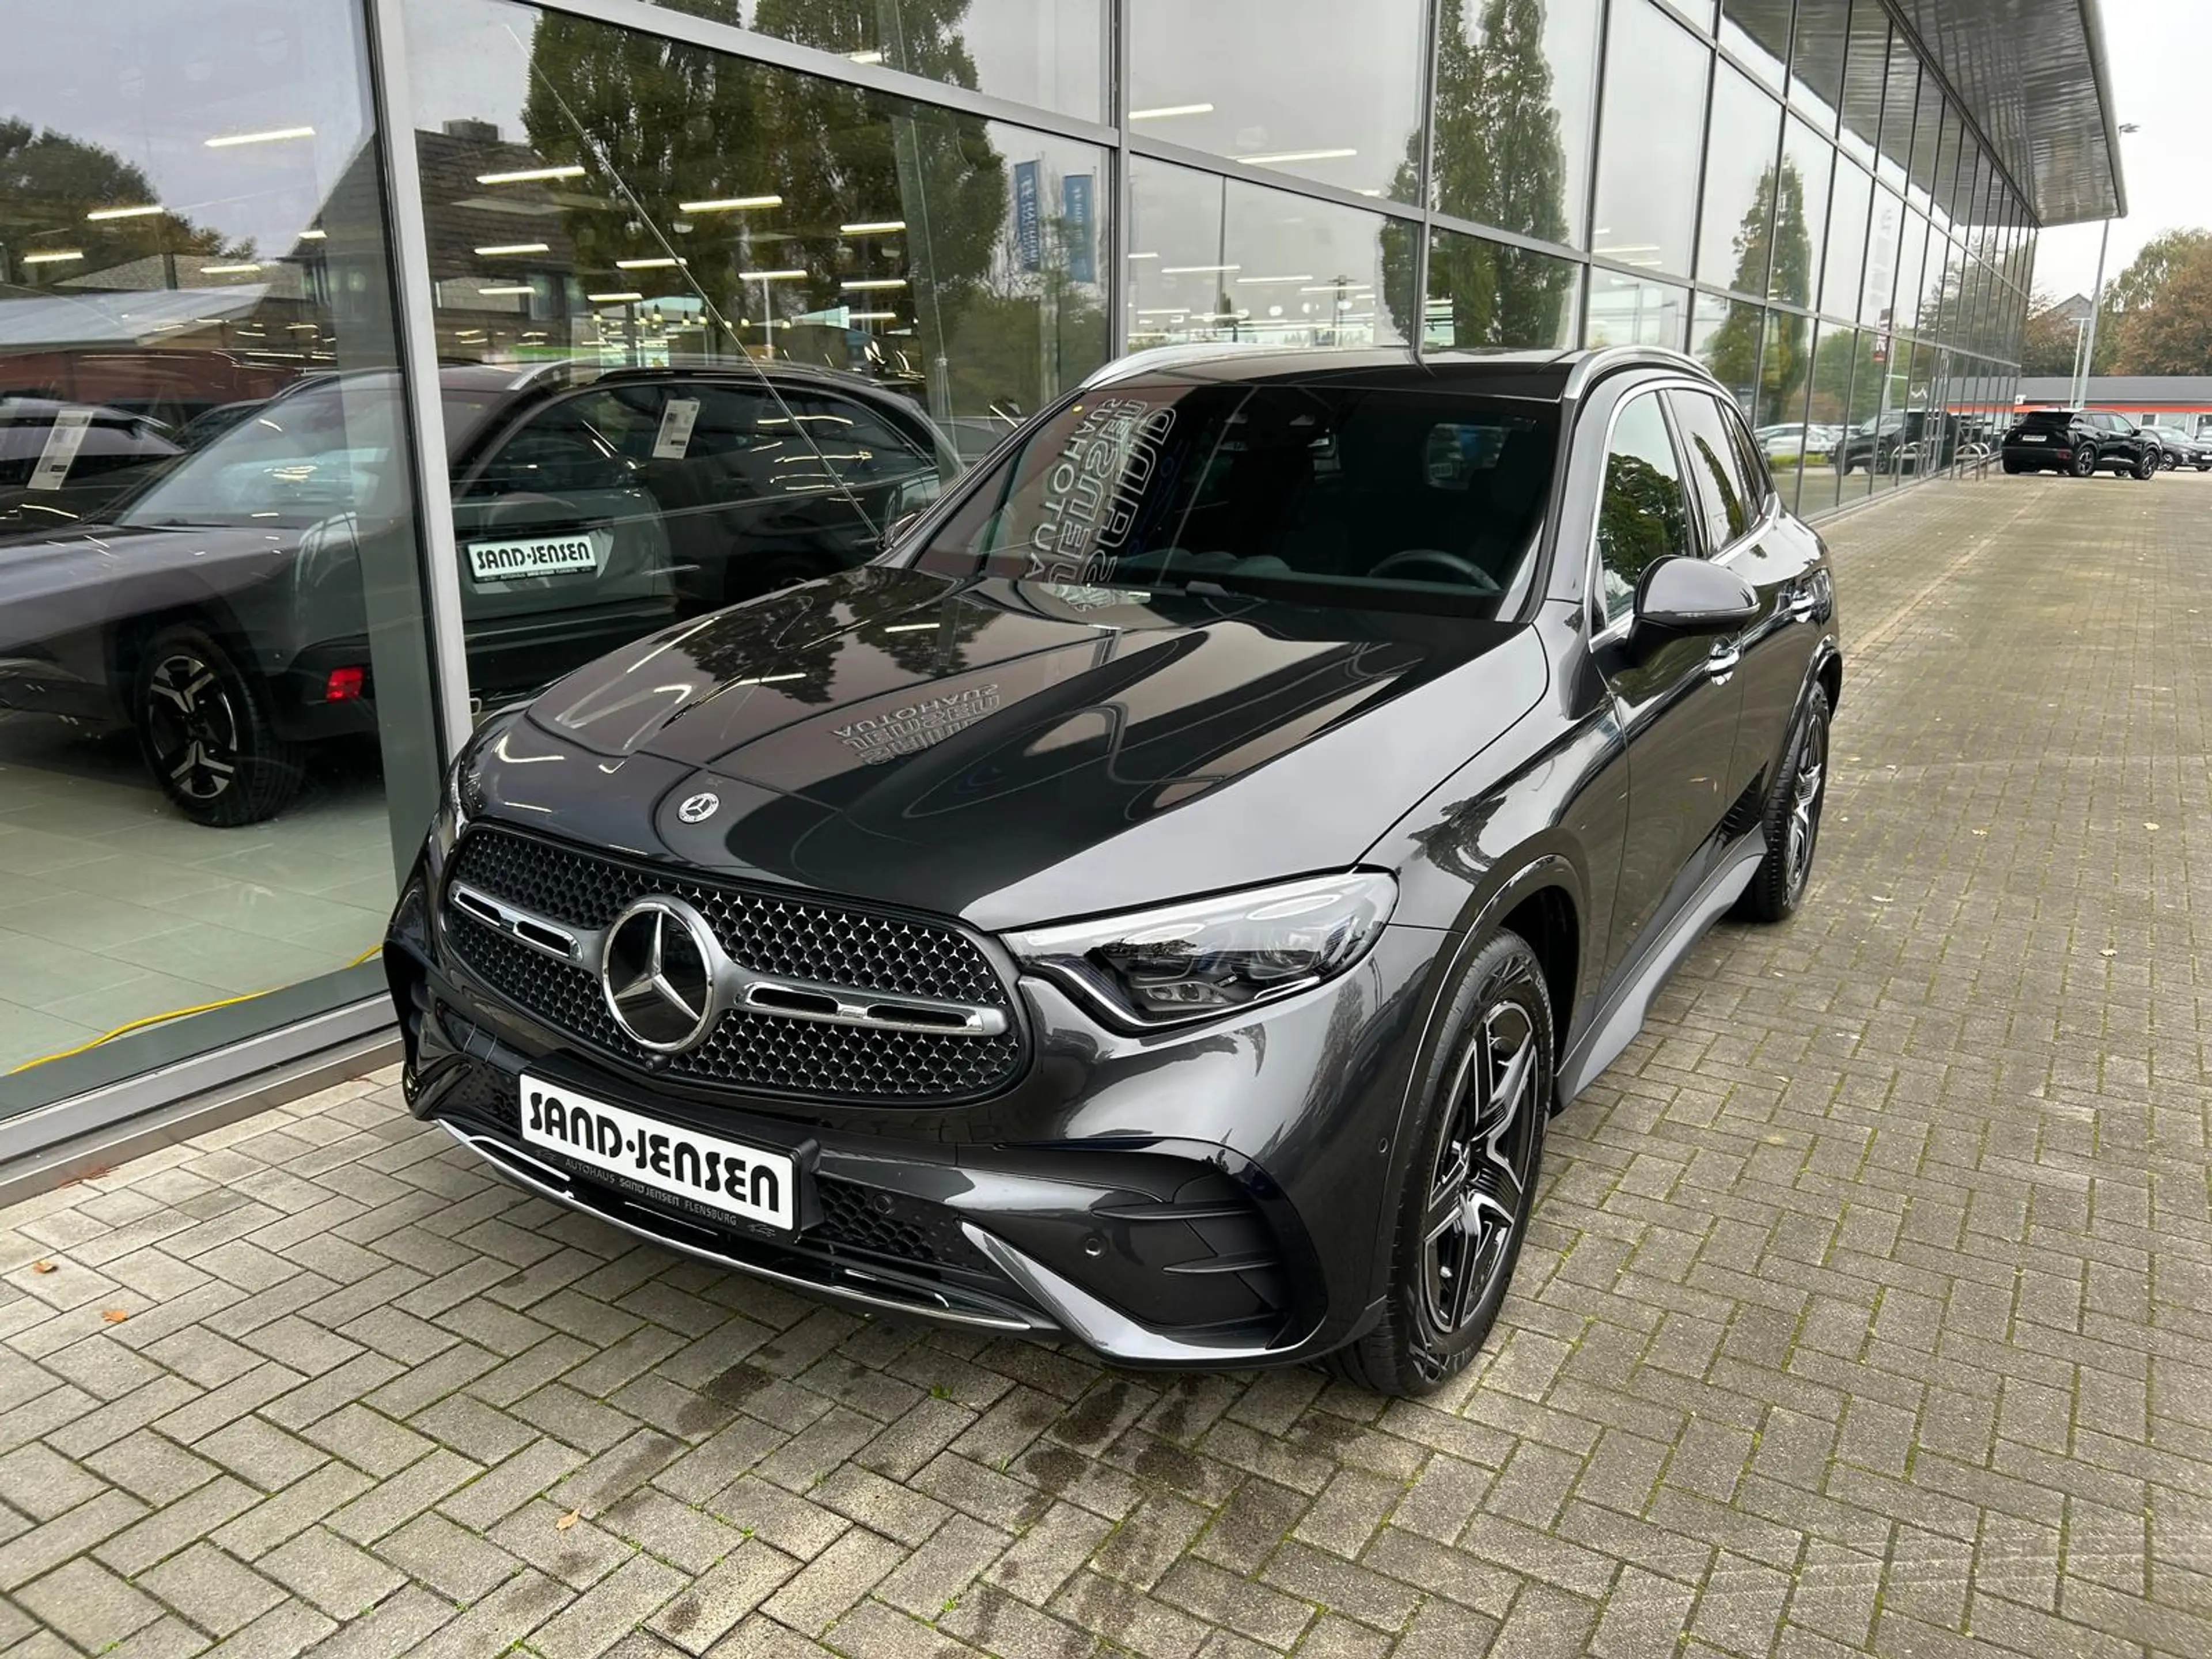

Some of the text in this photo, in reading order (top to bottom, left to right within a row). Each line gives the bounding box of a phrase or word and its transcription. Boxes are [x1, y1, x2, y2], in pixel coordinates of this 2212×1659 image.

[565, 1158, 737, 1226] AUTOHAUS SAND JENSEN FLENSBURG
